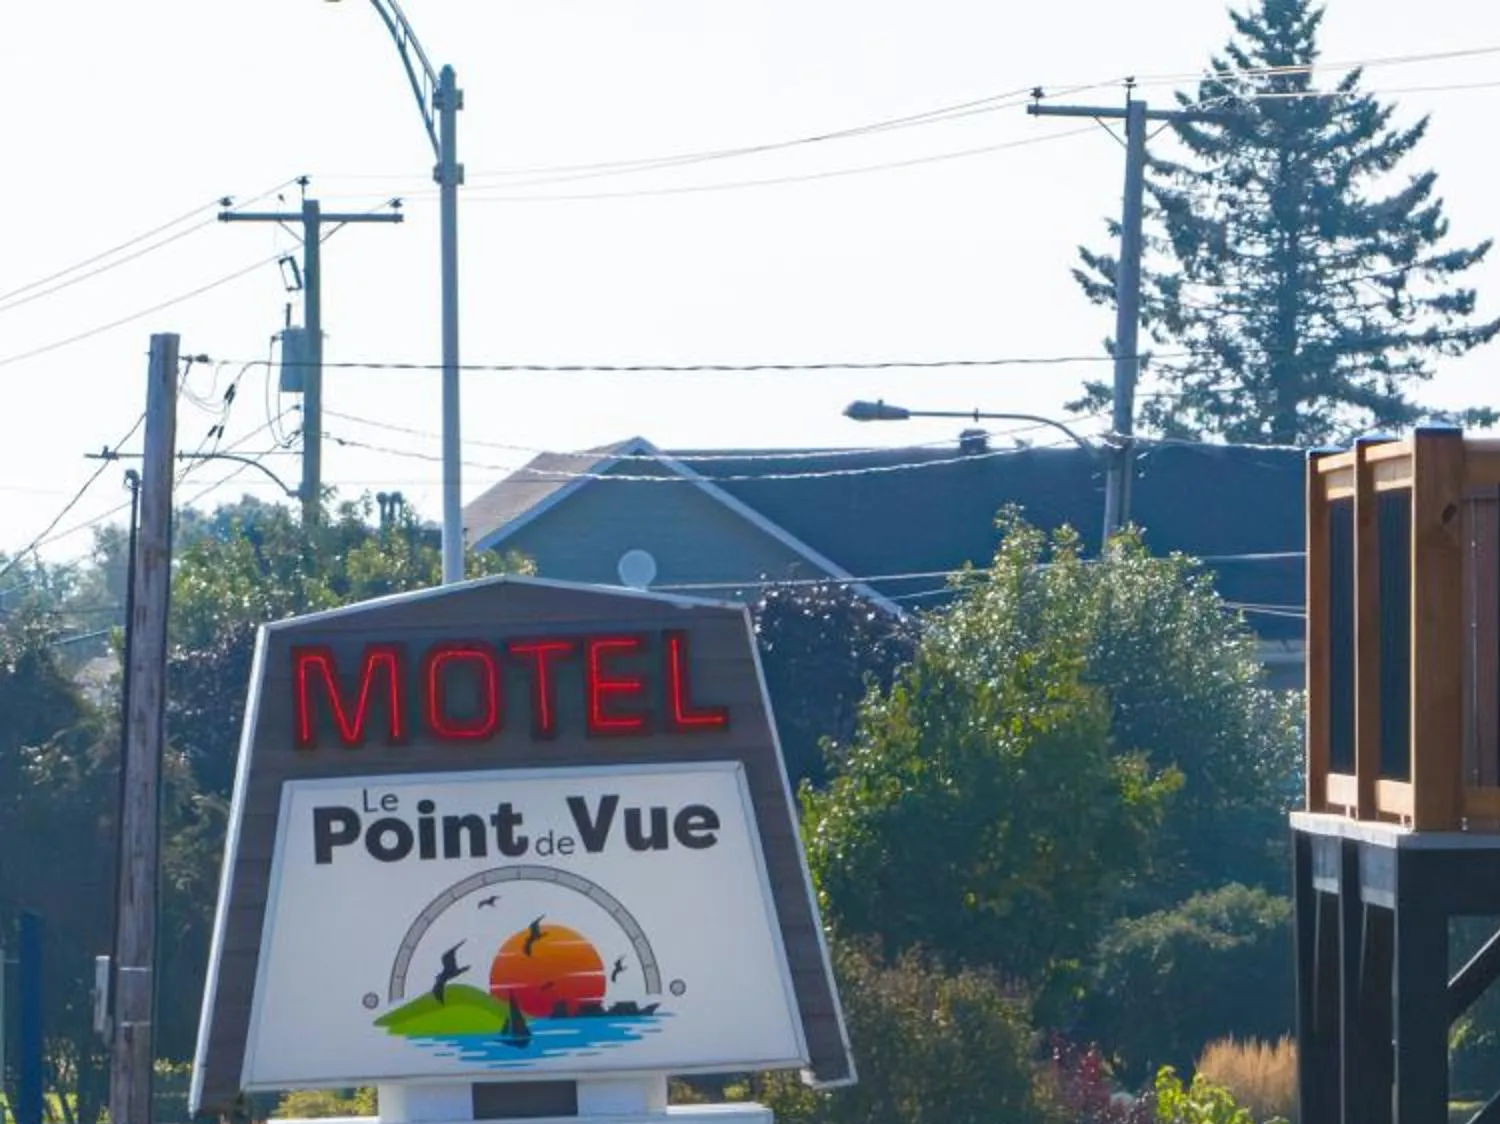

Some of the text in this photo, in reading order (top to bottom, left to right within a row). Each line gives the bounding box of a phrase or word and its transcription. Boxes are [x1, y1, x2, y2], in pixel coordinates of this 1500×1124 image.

[290, 629, 728, 749] MOTEL
[313, 794, 720, 865] Point de Vue
[363, 788, 399, 813] Le
